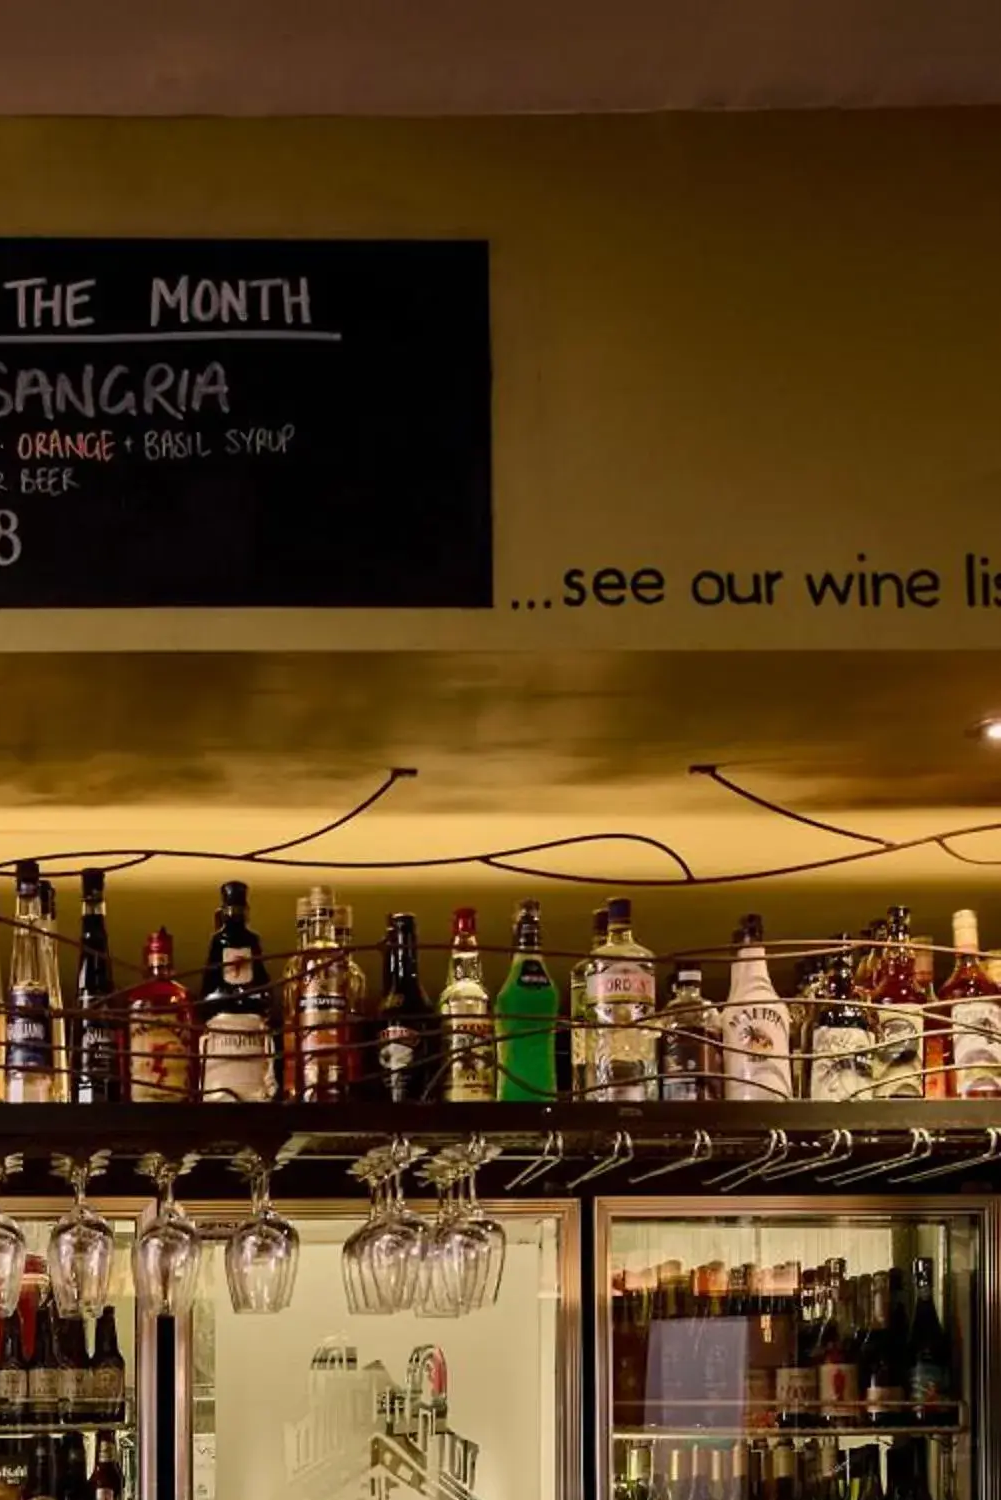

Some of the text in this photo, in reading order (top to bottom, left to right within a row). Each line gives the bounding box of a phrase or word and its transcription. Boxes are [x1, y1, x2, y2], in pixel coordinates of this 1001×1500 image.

[3, 277, 96, 329] THE
[150, 275, 311, 327] MONTH
[17, 429, 115, 462] ORANGE
[144, 429, 211, 461] BASIL
[225, 424, 295, 454] SYRUP
[20, 467, 76, 496] BEER
[691, 570, 784, 606] our
[805, 552, 941, 609] wine
